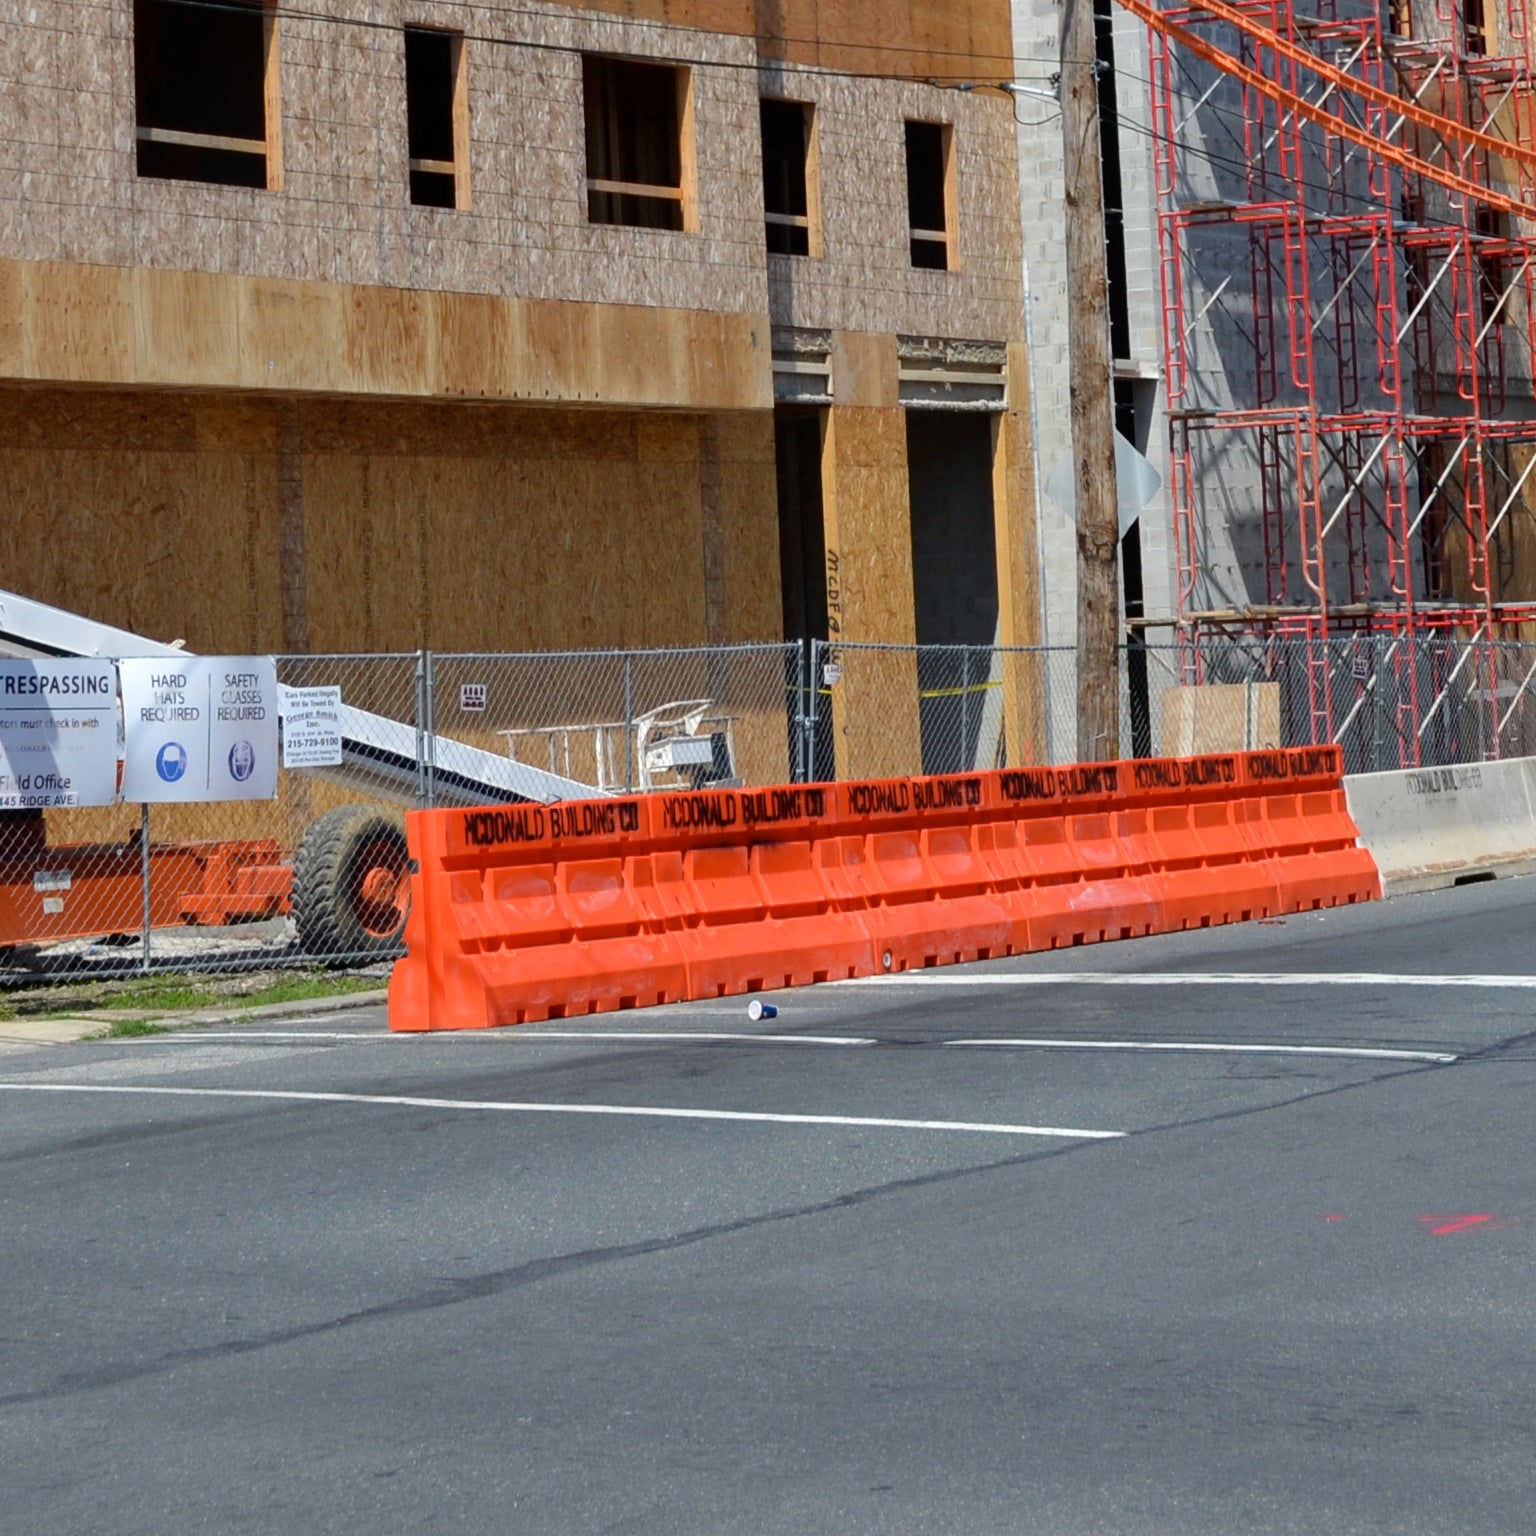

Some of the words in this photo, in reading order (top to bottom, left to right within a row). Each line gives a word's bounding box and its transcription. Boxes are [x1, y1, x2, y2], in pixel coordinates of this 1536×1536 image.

[151, 674, 187, 688] HARD
[224, 674, 259, 688] SAFETY
[154, 691, 185, 704] HATS
[221, 690, 262, 704] GLASSES
[140, 707, 200, 721] REQUIRED
[217, 707, 266, 721] REQUIRED
[20, 720, 42, 729] must
[45, 718, 70, 729] check
[72, 718, 80, 729] in
[81, 718, 99, 728] with
[287, 737, 339, 749] 215-729-9100
[0, 774, 30, 791] Fild
[33, 774, 71, 790] Office
[1000, 770, 1055, 800] MCDONALD
[1059, 767, 1102, 795] BUILDING
[19, 795, 50, 806] RIDGE
[848, 782, 910, 814] MCDONALD
[914, 779, 962, 810] BUILDING
[663, 794, 737, 829] MCDONALD
[741, 789, 802, 825] BUILDING
[465, 807, 545, 845] MCDONALD
[551, 802, 614, 838] BUILDING
[620, 801, 639, 831] CO
